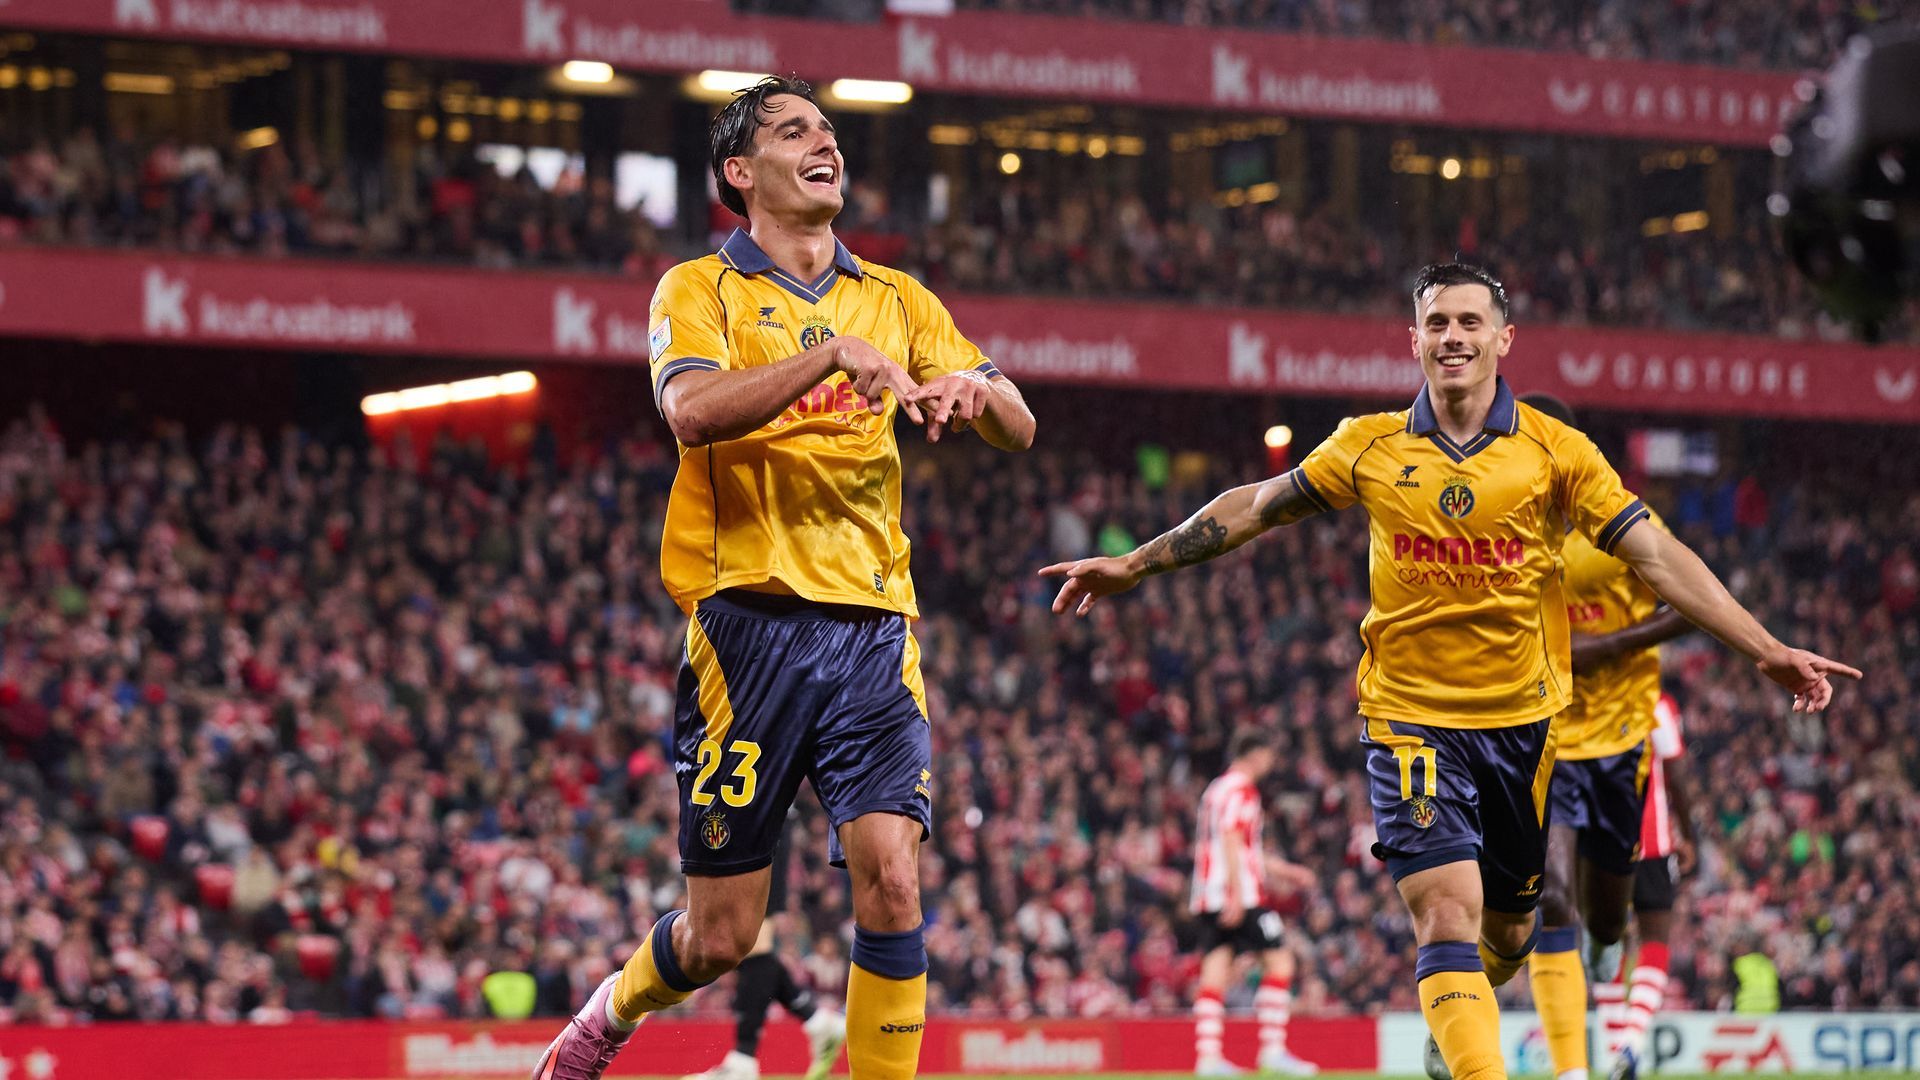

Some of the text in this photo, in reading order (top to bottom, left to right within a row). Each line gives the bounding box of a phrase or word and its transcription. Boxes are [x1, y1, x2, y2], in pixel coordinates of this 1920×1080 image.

[575, 21, 773, 69] kutxabank
[947, 48, 1137, 94] kutxabank
[1260, 73, 1441, 115] kutxabank
[202, 295, 414, 343] kutxabank
[1612, 352, 1808, 396] CASTORE
[1394, 533, 1525, 566] PAMESA
[691, 739, 762, 808] 23
[1392, 746, 1437, 800] 11
